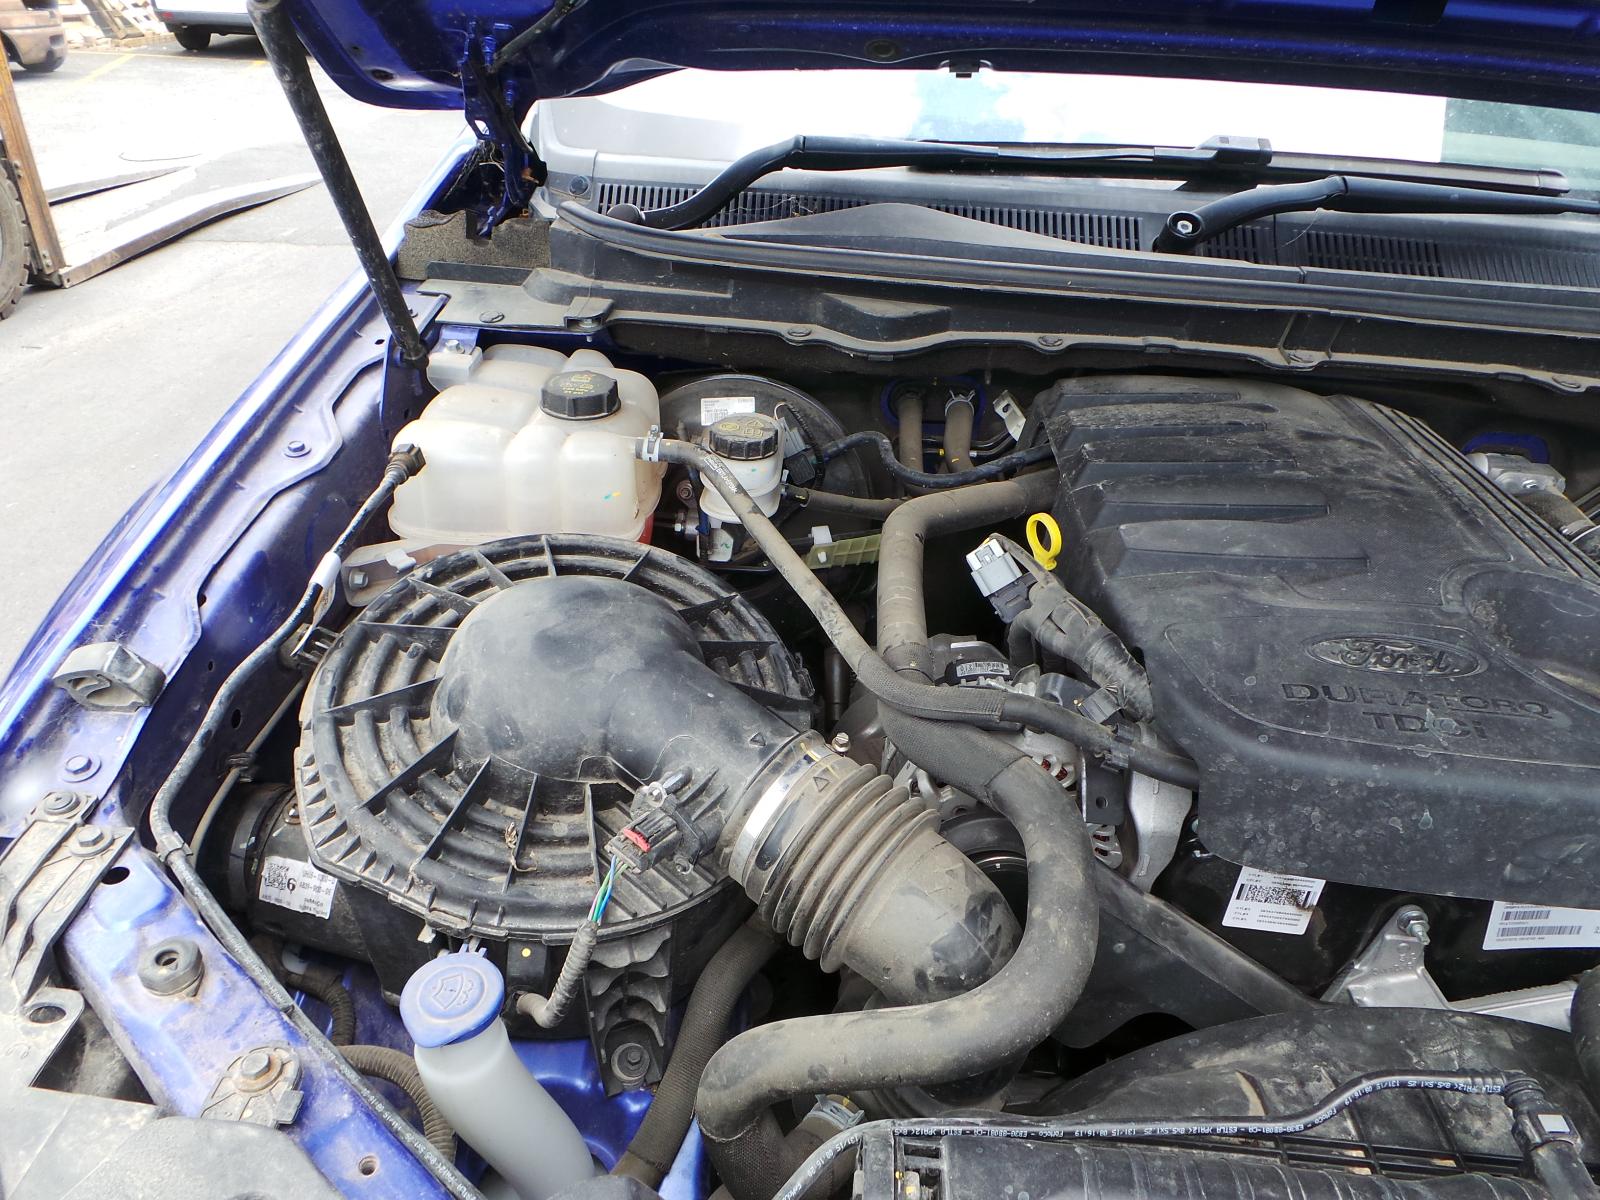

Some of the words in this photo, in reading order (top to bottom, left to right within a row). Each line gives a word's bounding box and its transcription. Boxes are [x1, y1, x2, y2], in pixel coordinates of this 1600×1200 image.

[1336, 638, 1450, 673] Ford
[1281, 682, 1552, 719] DURATORQ
[1362, 711, 1488, 739] TDCi
